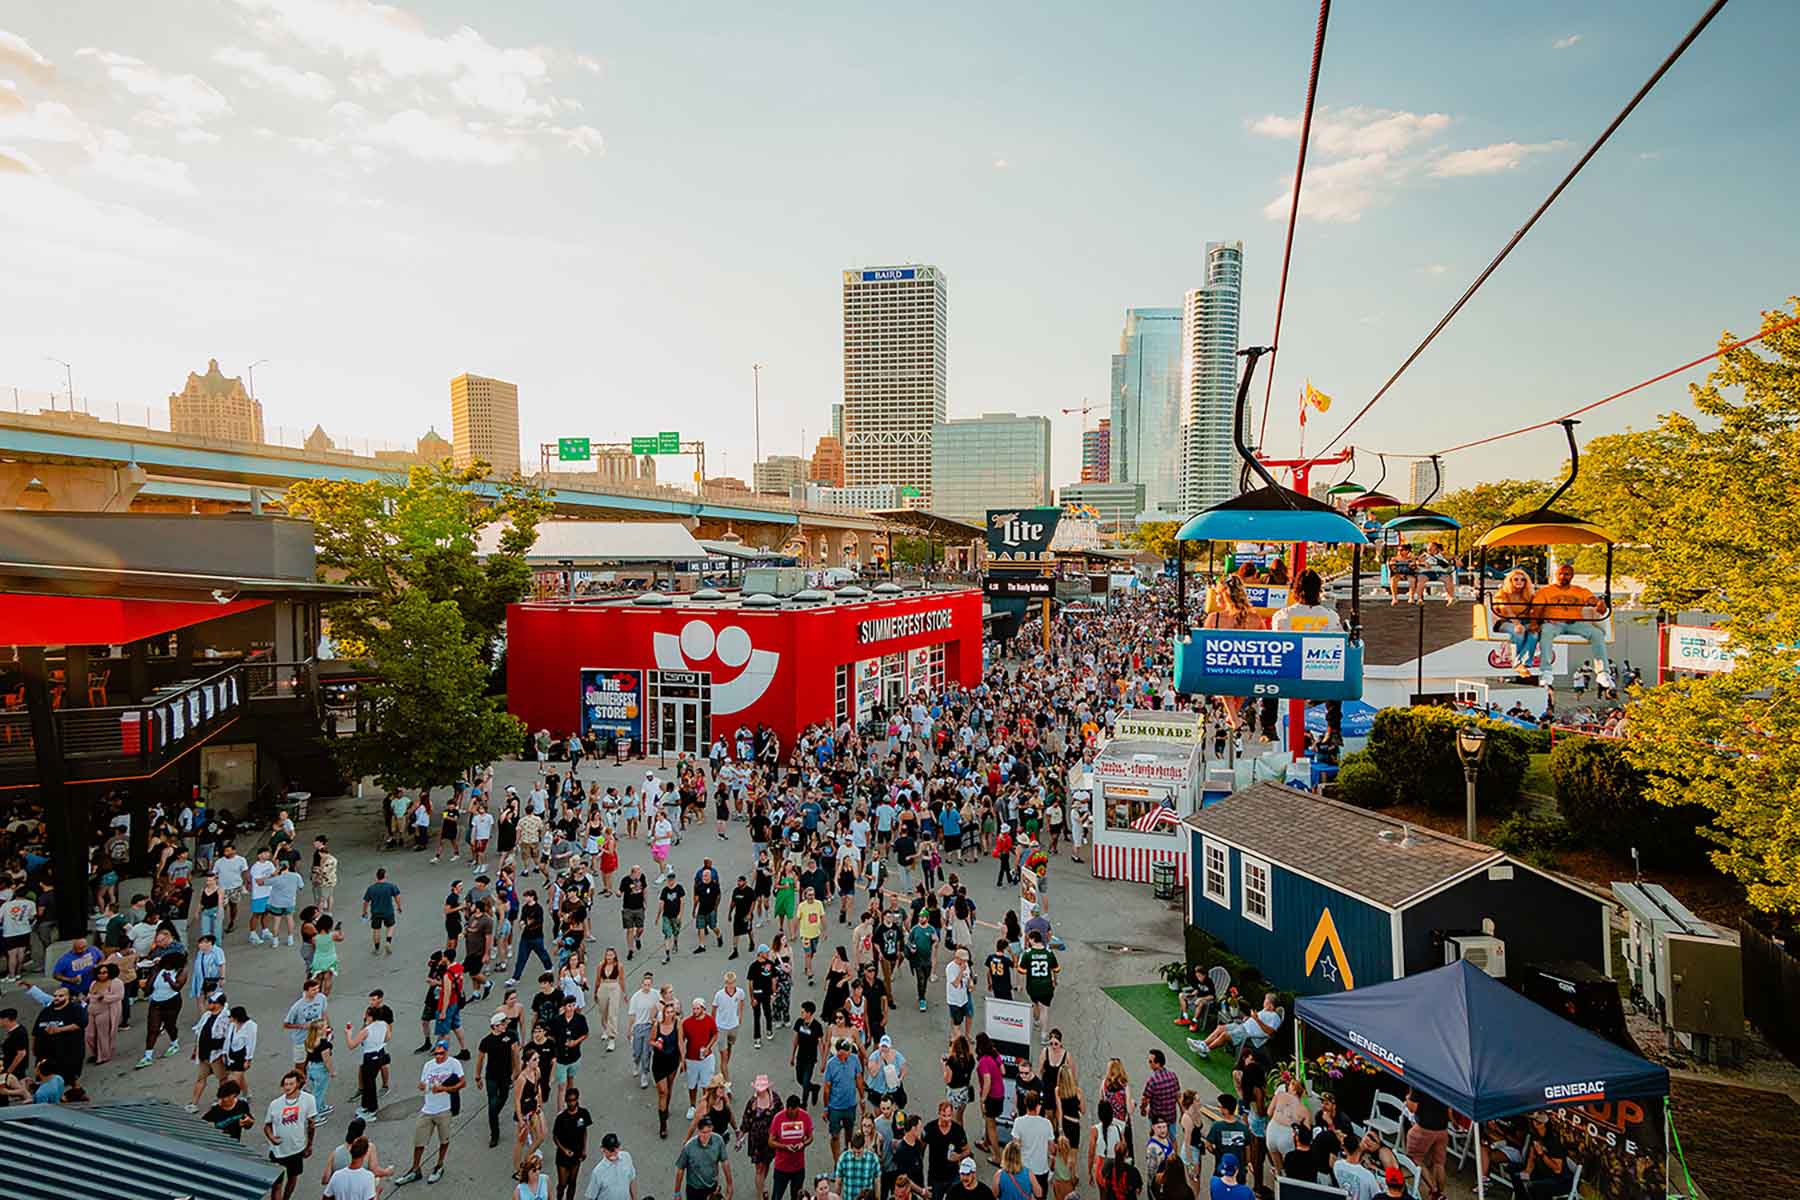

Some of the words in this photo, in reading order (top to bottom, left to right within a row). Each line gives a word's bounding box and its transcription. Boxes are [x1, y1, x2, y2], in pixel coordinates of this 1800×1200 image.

[874, 271, 903, 281] BAIRD
[1002, 520, 1044, 547] Lite
[861, 612, 926, 645] SUMMERFEST
[926, 608, 953, 632] STORE
[1205, 639, 1295, 654] NONSTOP
[1205, 653, 1283, 667] SEATTLE
[1306, 649, 1342, 660] MKE
[602, 679, 620, 691] THE
[1253, 684, 1280, 694] 59
[585, 692, 637, 705] SUMMERFEST
[594, 706, 627, 719] STORE
[1121, 724, 1193, 738] LEMONADE
[1031, 960, 1049, 976] 23
[1348, 1031, 1405, 1069] GENERAC
[1544, 1081, 1605, 1099] GENERAC
